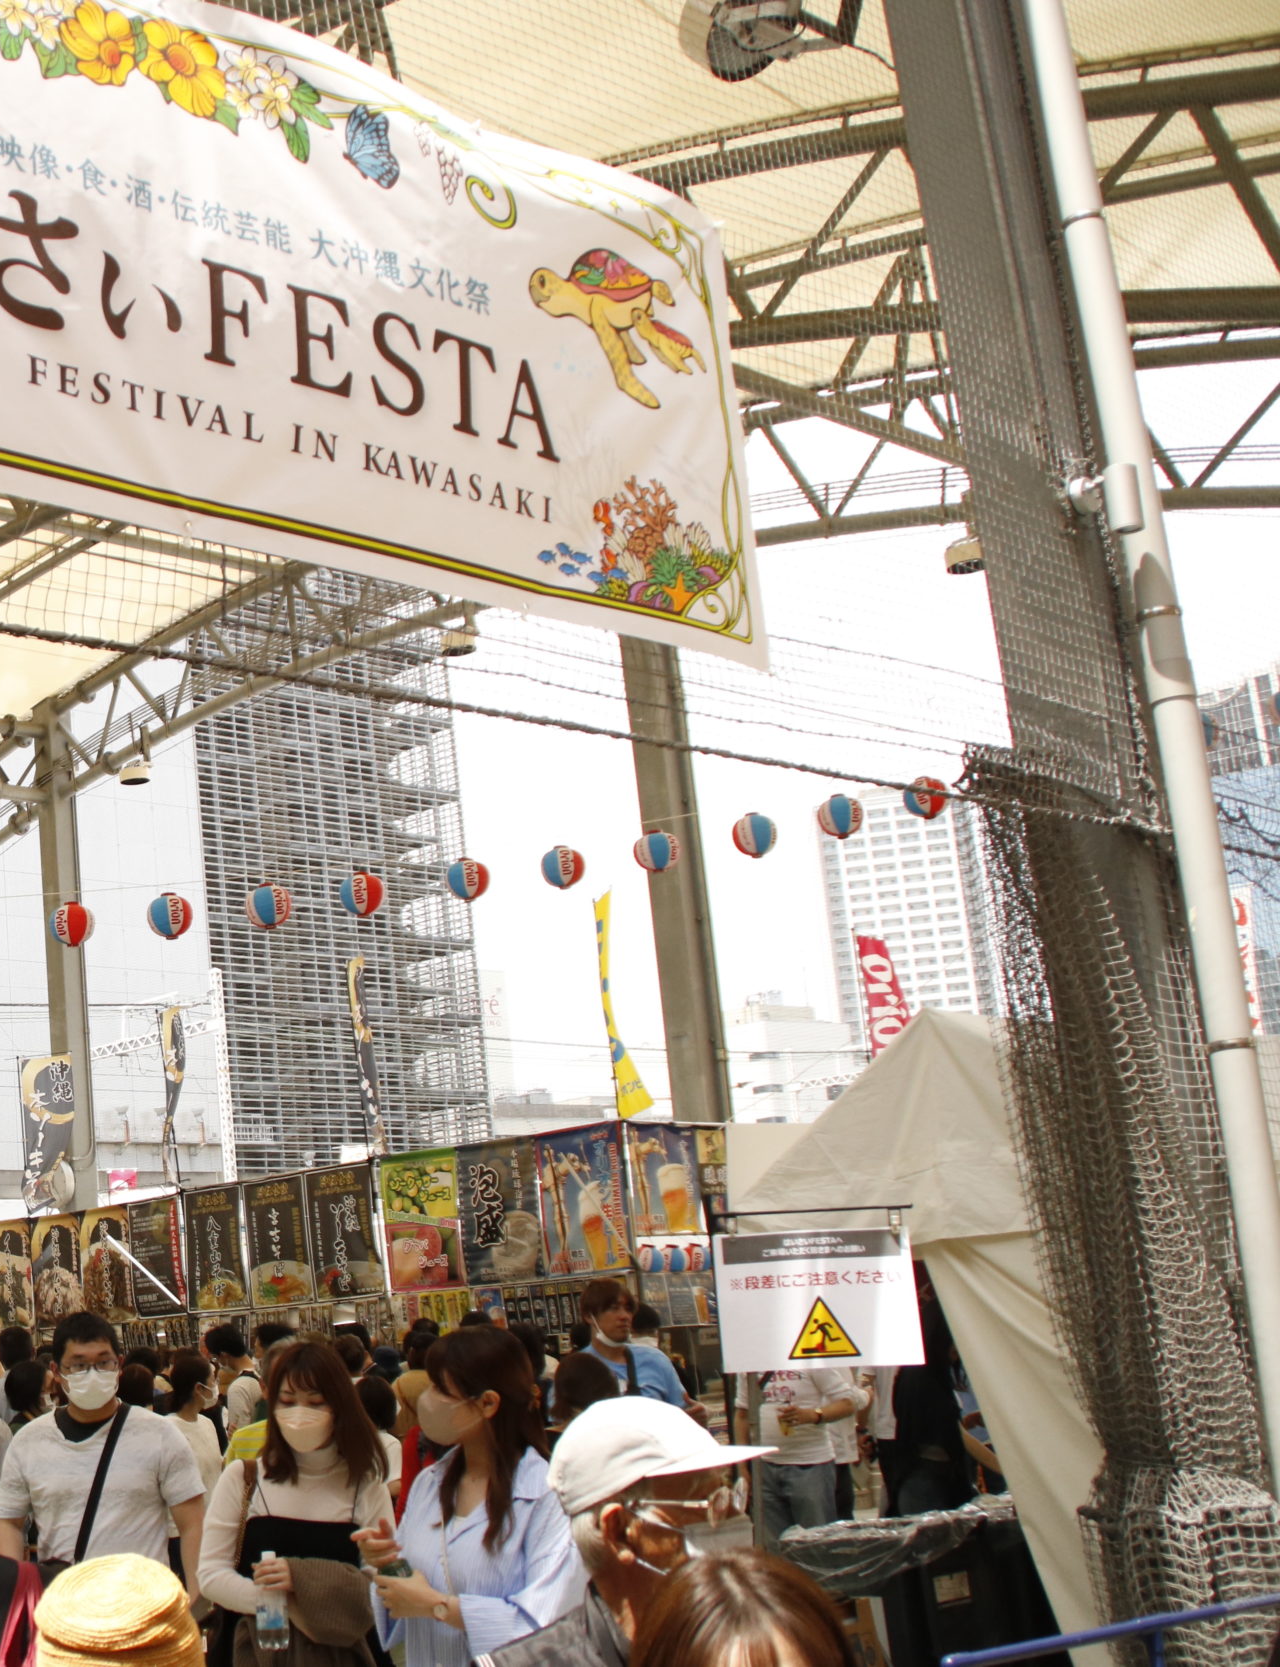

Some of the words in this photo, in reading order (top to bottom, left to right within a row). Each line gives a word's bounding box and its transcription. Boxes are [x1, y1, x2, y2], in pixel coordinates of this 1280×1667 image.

[310, 229, 491, 316] 大沖縄文化祭
[28, 354, 265, 442] FESTIVAL
[291, 423, 337, 462] IN
[363, 443, 552, 523] KAWASAKI
[464, 861, 479, 887] Orion
[560, 849, 574, 875] Orion
[273, 888, 287, 916] Orion
[353, 877, 368, 905] Orion
[55, 909, 68, 936] Orion
[169, 898, 183, 926] Orion
[50, 1060, 74, 1102] 沖縄
[344, 1194, 361, 1232] 沖縄
[469, 1163, 508, 1249] 泡盛
[206, 1215, 225, 1297] 八重山そば
[268, 1207, 286, 1279] 宮古そば
[730, 1270, 903, 1291] ※段差にご注意ください
